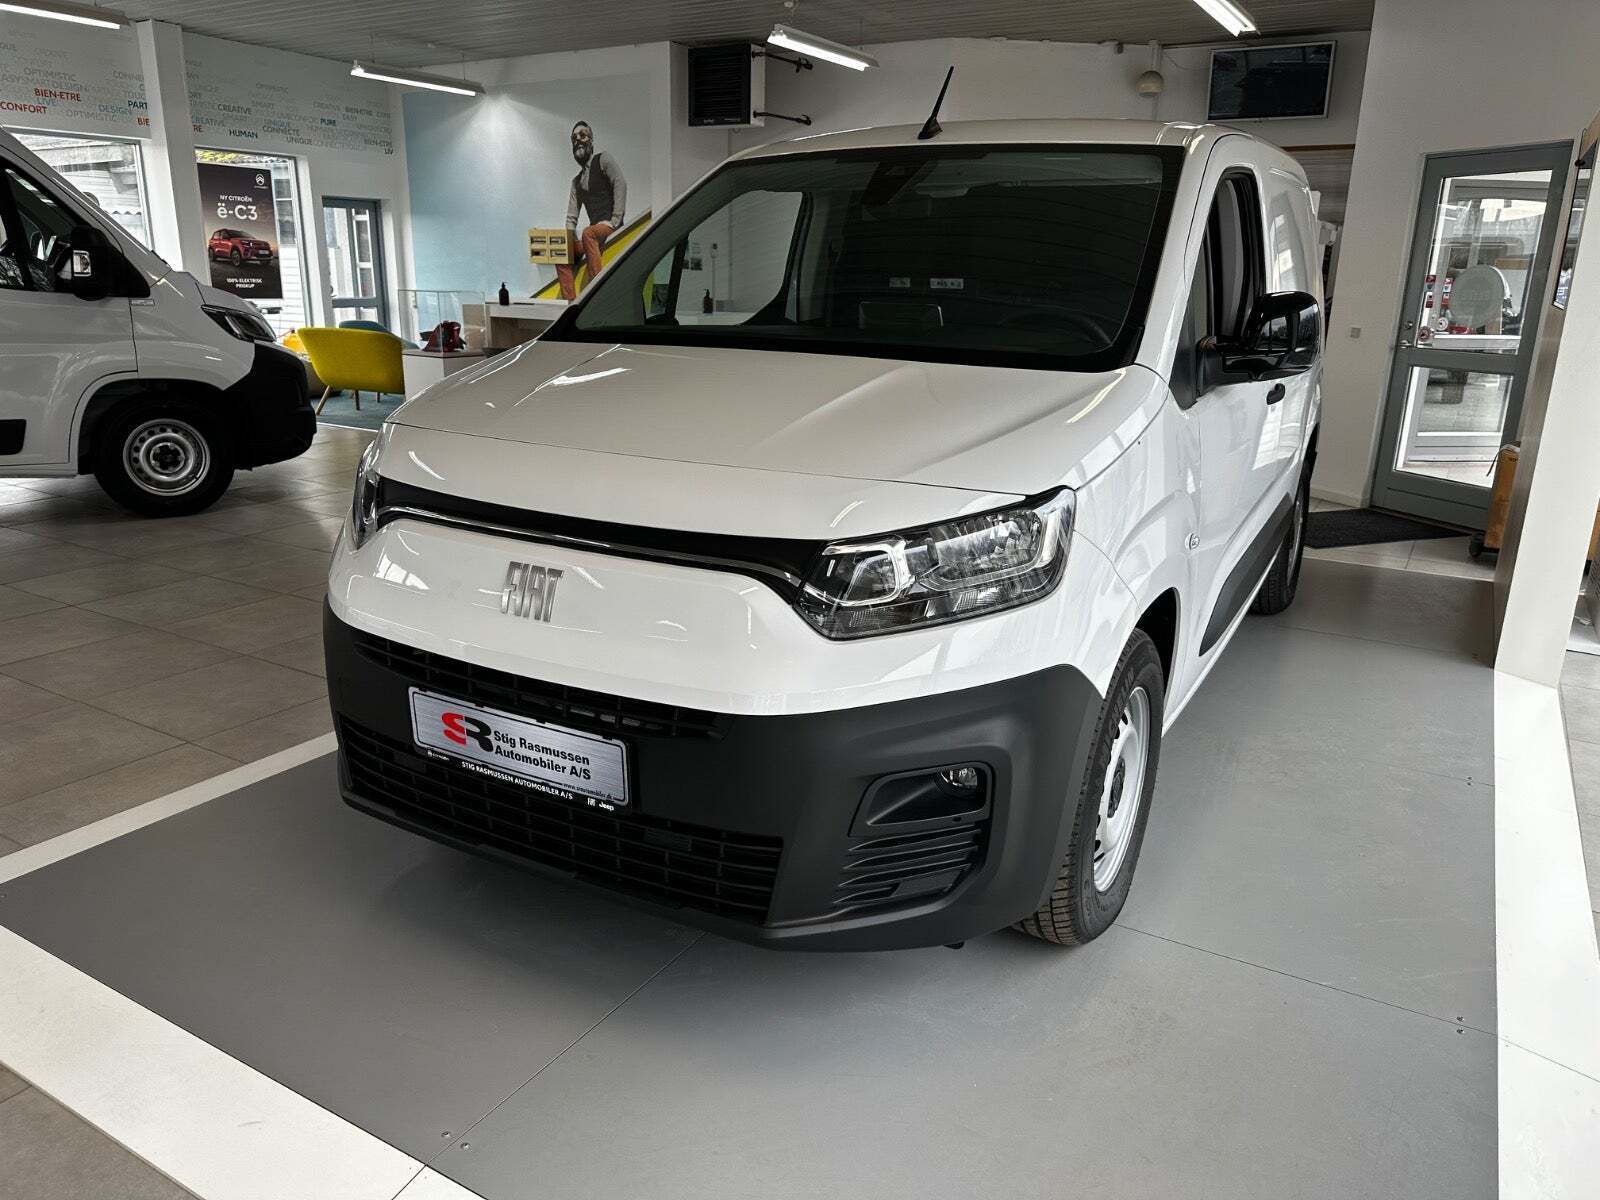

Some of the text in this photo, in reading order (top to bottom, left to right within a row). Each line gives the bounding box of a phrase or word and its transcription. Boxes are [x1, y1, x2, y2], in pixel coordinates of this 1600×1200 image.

[23, 66, 77, 81] OPTIMISTIC
[34, 87, 81, 102] BIEN-ETRE
[0, 101, 47, 114] CONFORT
[217, 103, 252, 115] CREATIVE
[320, 118, 337, 127] PURE
[229, 129, 258, 139] HUMAN
[286, 136, 312, 146] UNIQUE
[216, 202, 258, 220] ë-C3
[501, 561, 563, 623] FIAT
[493, 730, 591, 766] Stig Rasmussen
[494, 746, 592, 780] Automobiler A/S
[460, 761, 574, 800] STIG RASMUSSEN AUTOMOBILER A/S
[598, 801, 615, 811] Jeep
